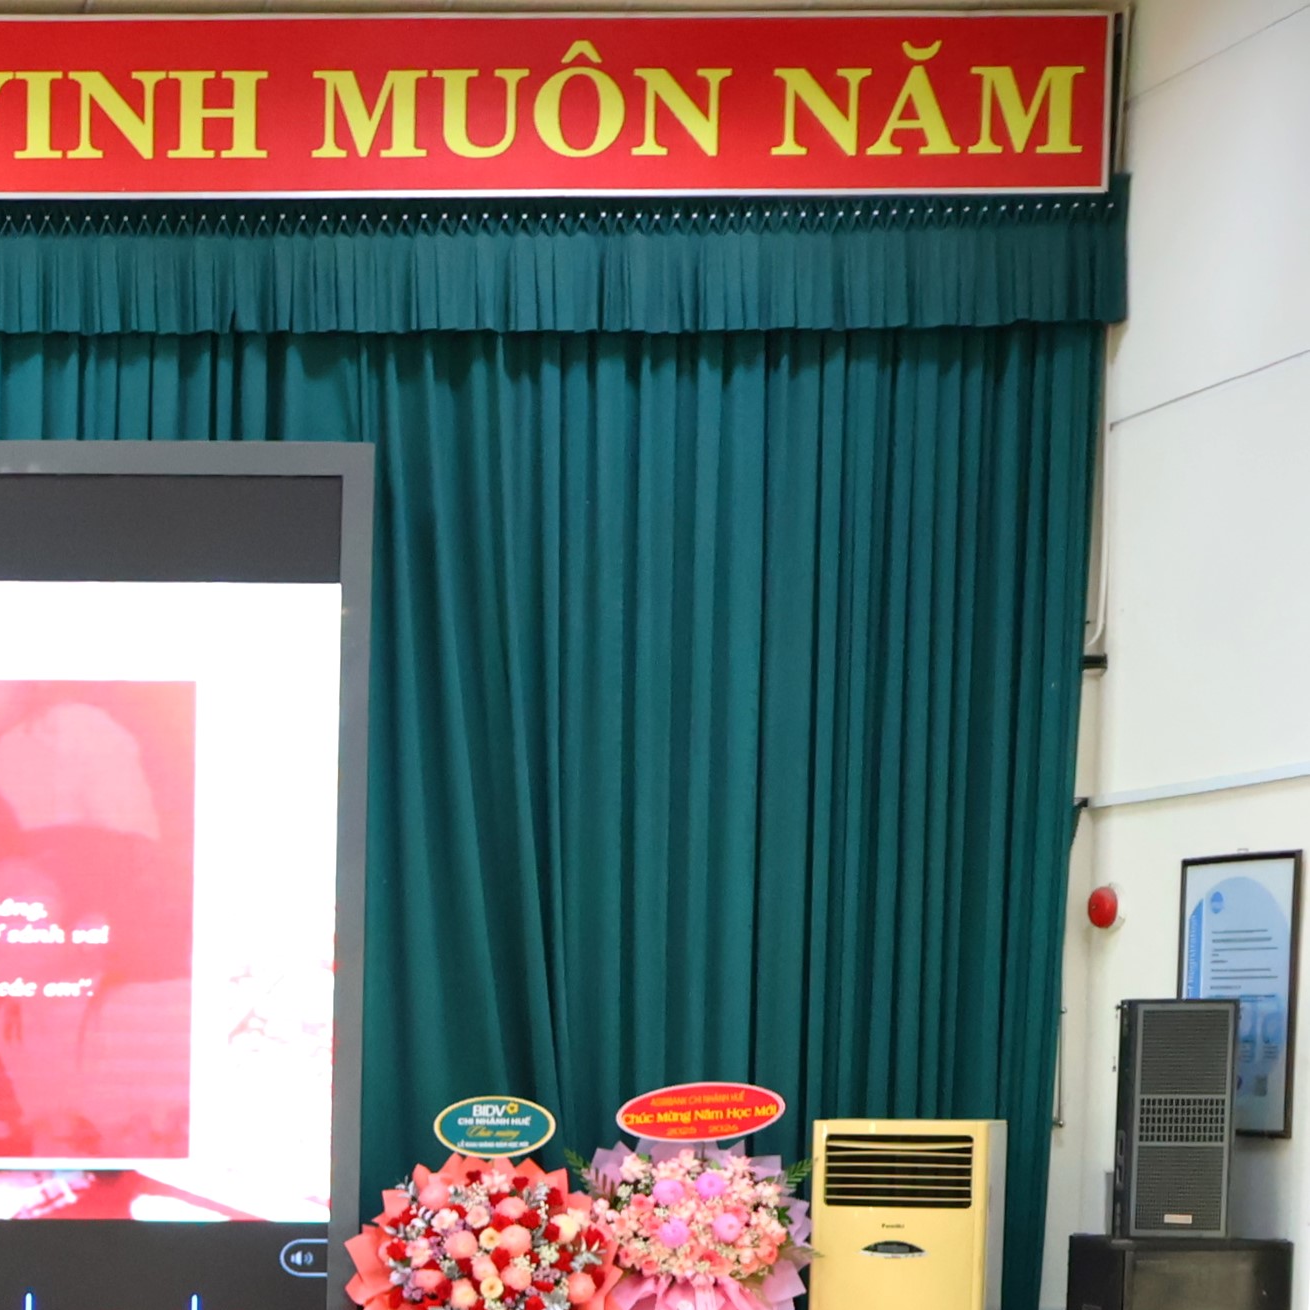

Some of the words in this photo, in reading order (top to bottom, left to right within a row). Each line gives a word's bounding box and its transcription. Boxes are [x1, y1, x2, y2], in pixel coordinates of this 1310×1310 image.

[312, 41, 732, 158] MUÔN
[770, 40, 1086, 156] NĂM
[472, 1104, 506, 1118] BIDV
[623, 1111, 654, 1126] Chúc
[656, 1109, 693, 1124] Mừng
[694, 1107, 724, 1121] Năm
[726, 1106, 752, 1120] Học
[754, 1104, 778, 1117] Mới
[457, 1117, 474, 1126] CHI
[475, 1116, 510, 1126] NHÁNH
